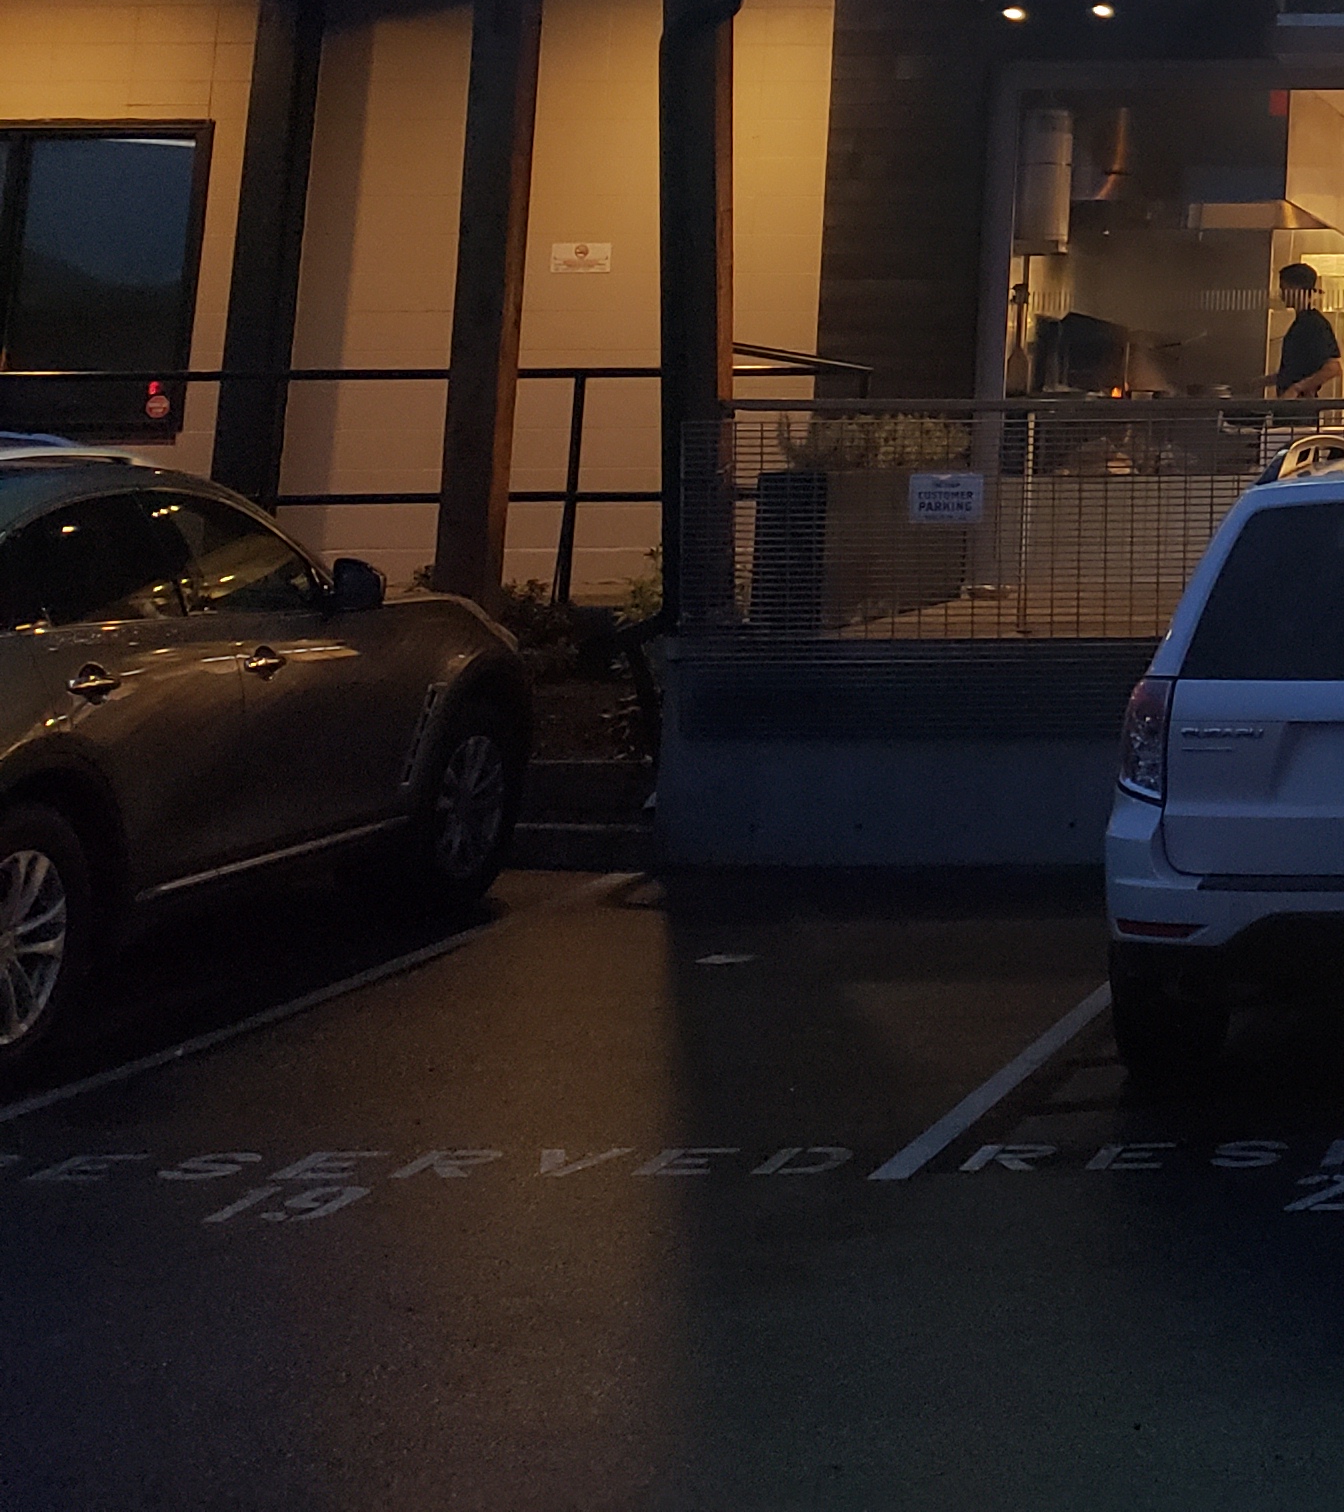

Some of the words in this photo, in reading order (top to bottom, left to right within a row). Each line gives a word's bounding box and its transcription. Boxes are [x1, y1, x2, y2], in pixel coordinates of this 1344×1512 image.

[918, 491, 974, 500] CUSTOMER
[918, 501, 973, 512] PARKING
[200, 1185, 376, 1225] 19
